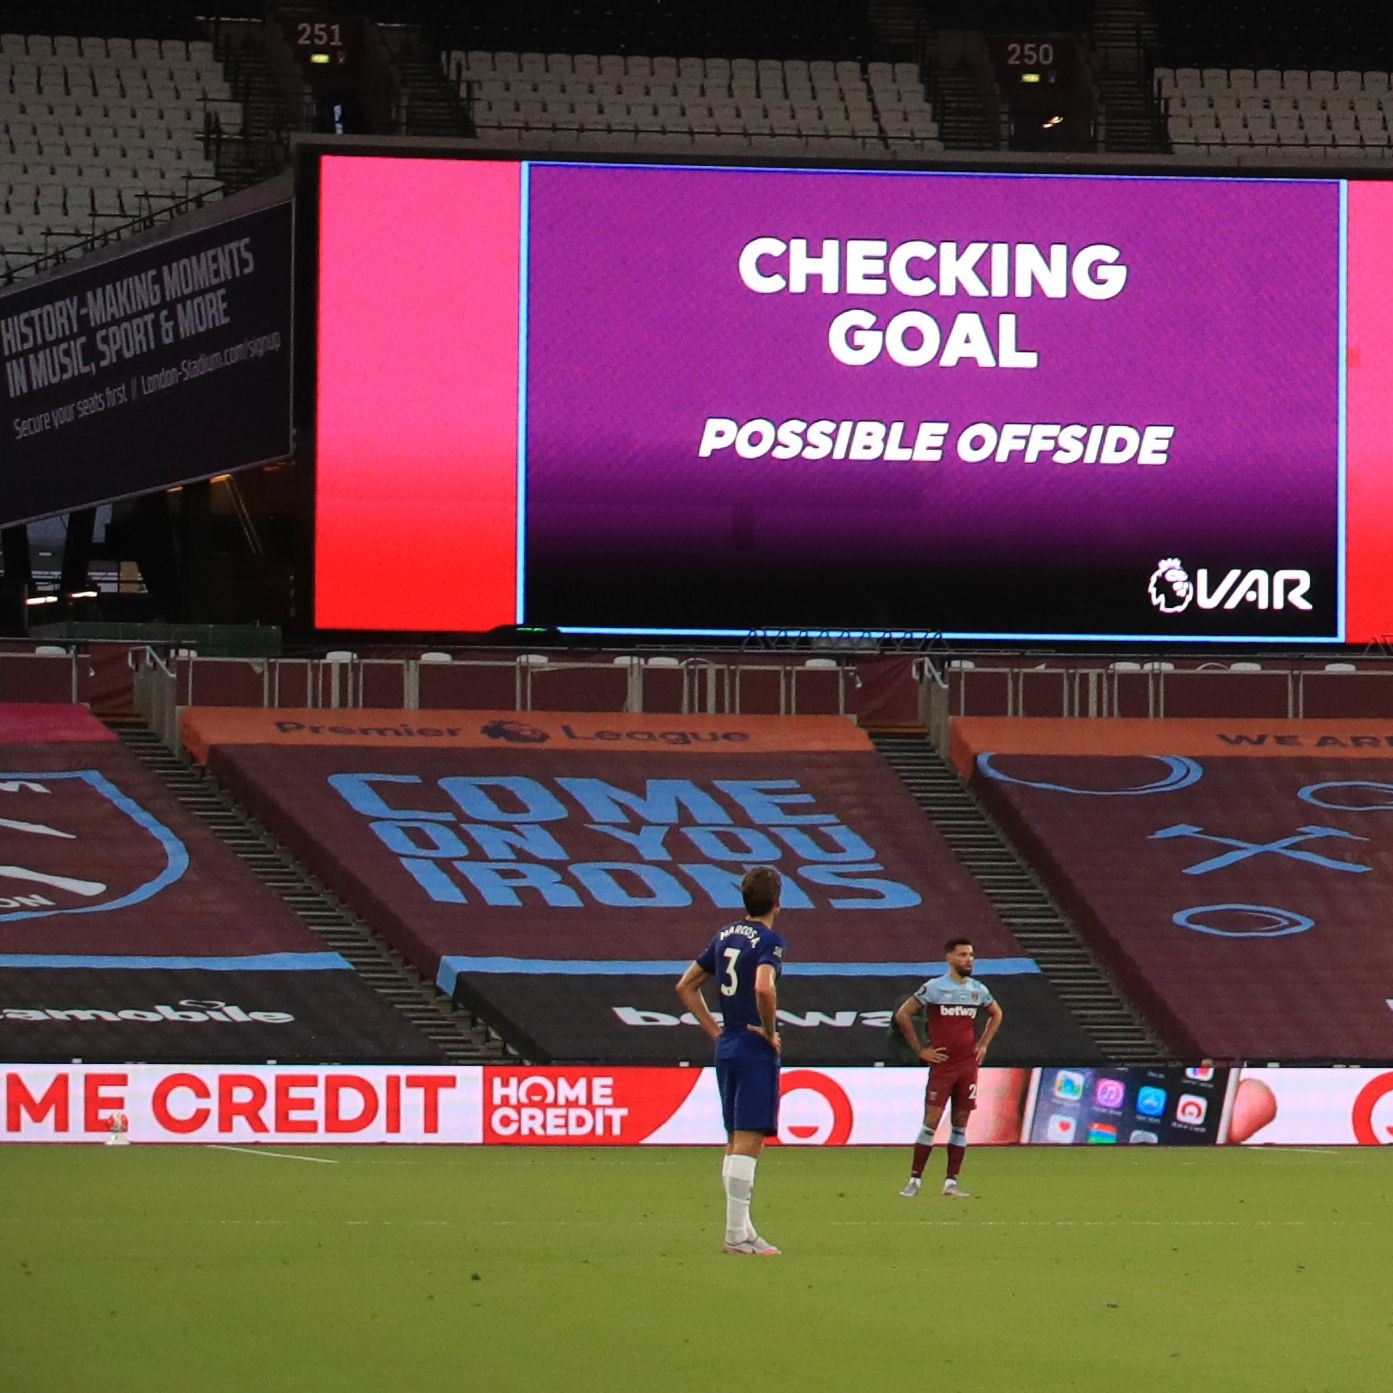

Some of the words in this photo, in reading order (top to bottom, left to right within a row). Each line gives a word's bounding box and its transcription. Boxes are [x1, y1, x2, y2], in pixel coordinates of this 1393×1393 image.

[297, 22, 343, 47] 251
[1007, 43, 1054, 66] 250
[738, 237, 1128, 301] CHECKING
[1, 269, 162, 356] HISTORY-MAKING
[162, 237, 254, 301] MOMENTS
[6, 357, 29, 398] IN
[31, 336, 97, 391] MUSIC,
[96, 312, 156, 368] SPORT
[160, 310, 175, 344] &
[177, 288, 231, 340] MORE
[828, 308, 1038, 369] GOAL
[14, 412, 51, 440] Secure
[51, 404, 77, 430] your
[77, 393, 105, 419] seats
[698, 418, 949, 462] POSSIBLE
[957, 422, 1174, 466] OFFSIDE
[1195, 569, 1314, 611] VAR
[274, 720, 465, 741] Premier
[561, 724, 751, 746] League
[1217, 734, 1300, 747] WE
[327, 772, 842, 826] COME
[368, 820, 572, 861] ON
[583, 824, 878, 863] YOU
[399, 856, 924, 909] IRONS
[720, 947, 741, 997] 3
[0, 999, 295, 1023] amobile
[940, 1005, 977, 1019] betway
[152, 1072, 457, 1134] CREDIT
[492, 1076, 615, 1107] HOME
[490, 1107, 629, 1138] CREDIT
